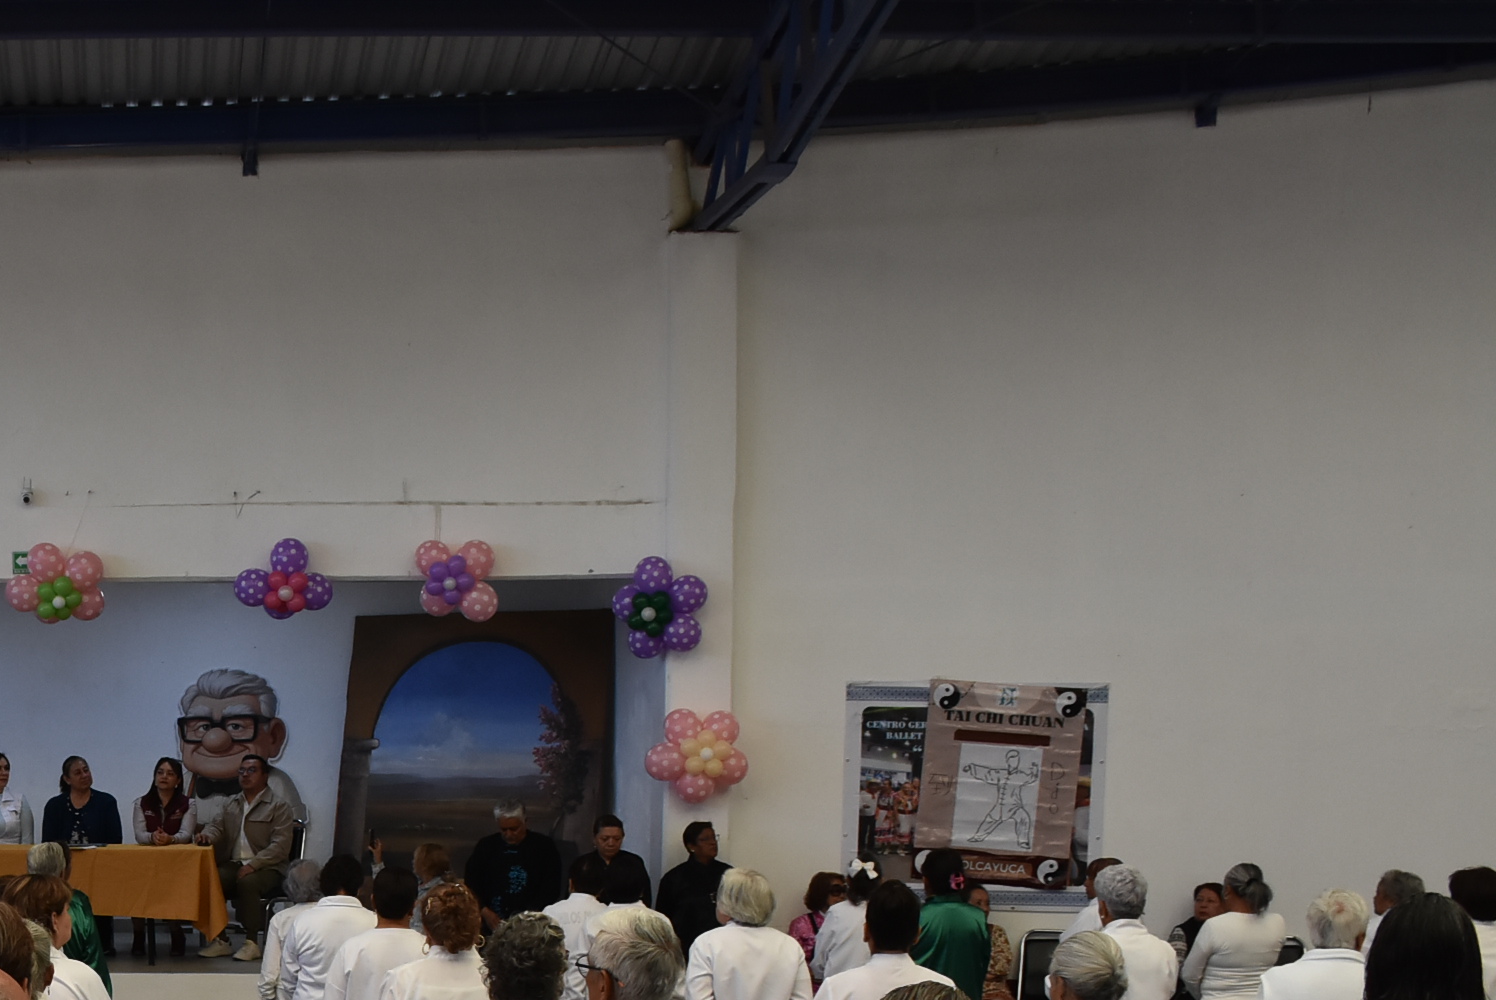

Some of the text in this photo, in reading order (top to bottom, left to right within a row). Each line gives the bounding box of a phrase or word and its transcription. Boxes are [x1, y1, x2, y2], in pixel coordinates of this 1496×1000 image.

[866, 720, 907, 729] CENTRO
[944, 709, 1066, 729] TAI CHI CHUAN
[886, 731, 924, 740] BALLET
[961, 859, 1026, 875] OLCAYUCA
